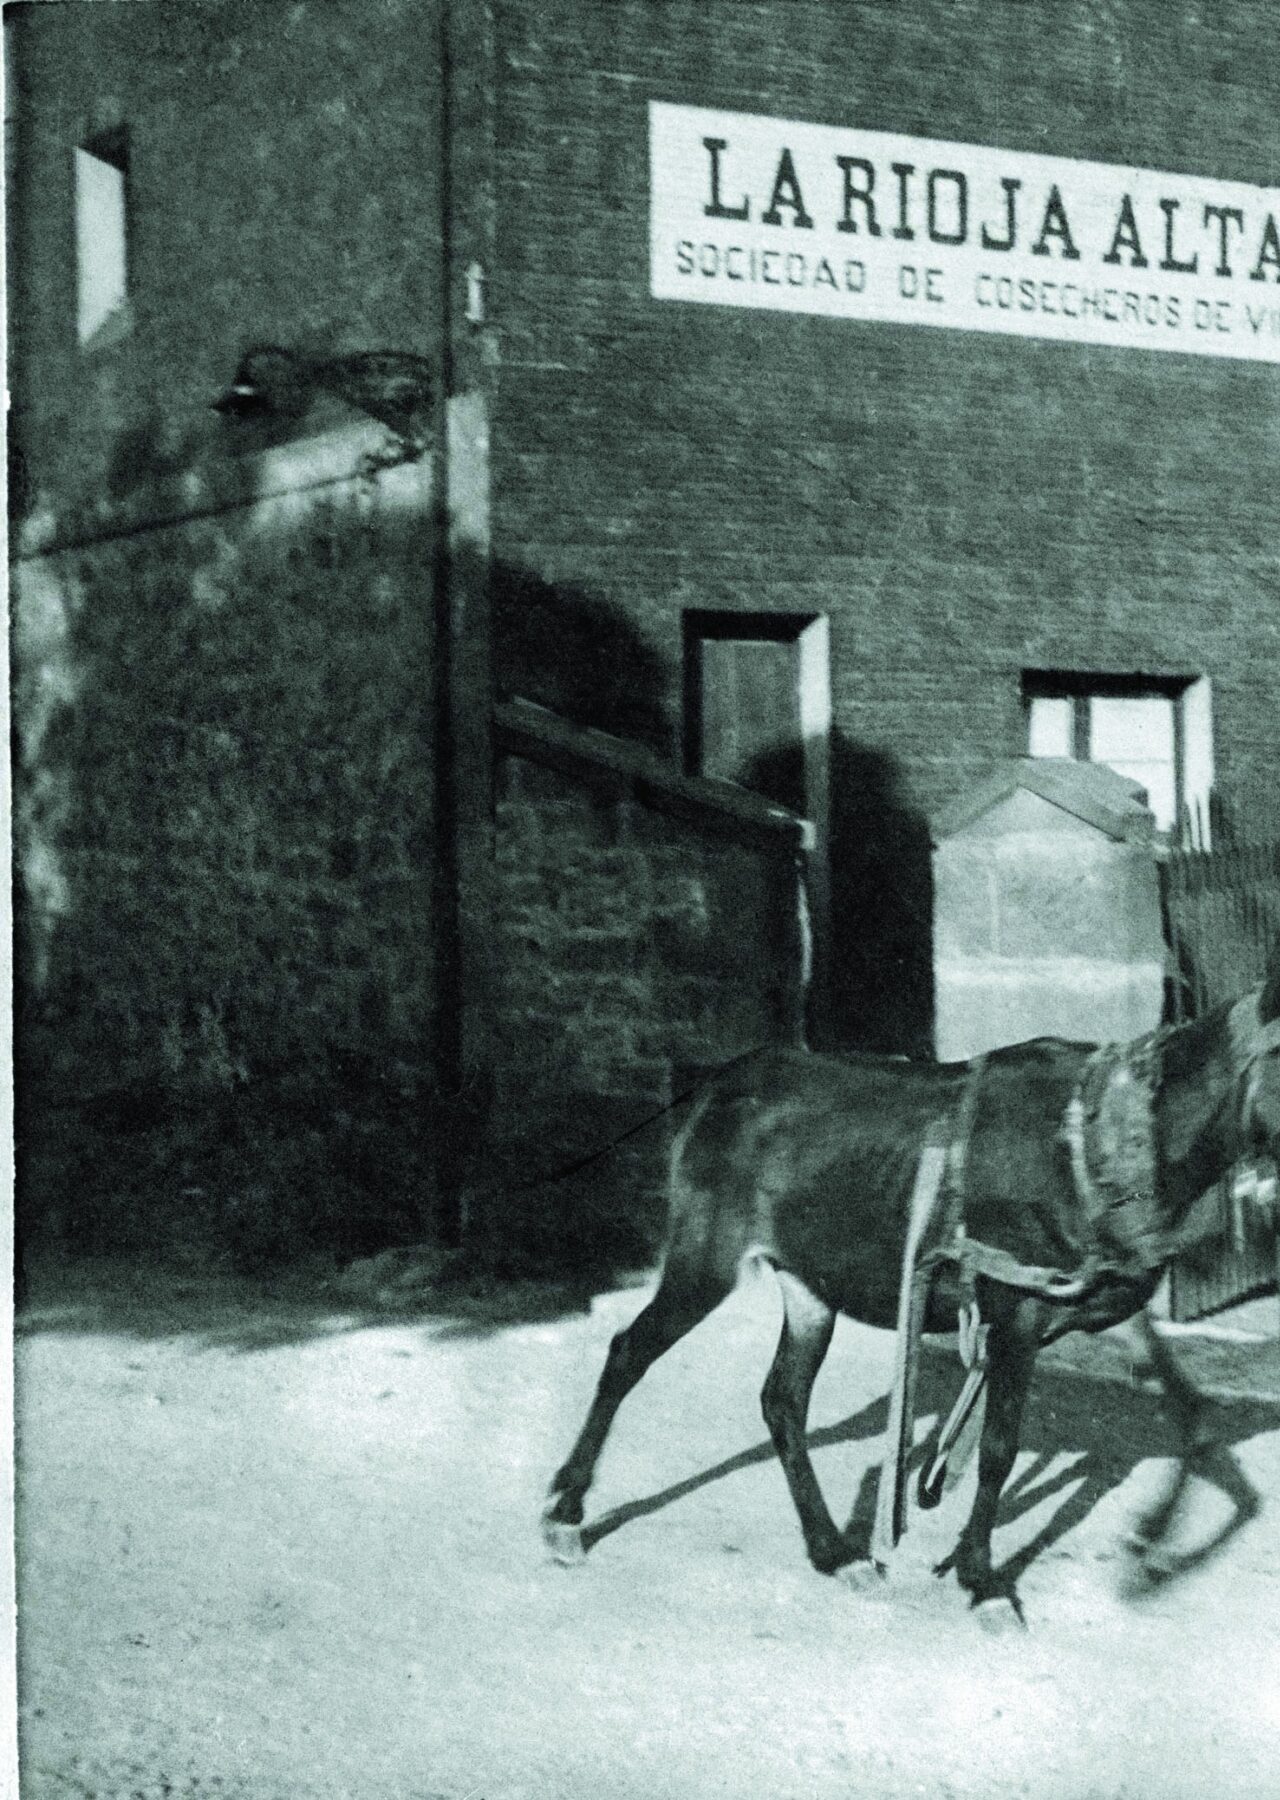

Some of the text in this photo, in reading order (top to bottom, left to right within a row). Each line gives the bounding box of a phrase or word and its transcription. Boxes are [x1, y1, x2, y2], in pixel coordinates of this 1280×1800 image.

[702, 137, 813, 229] LA
[836, 155, 1080, 260] RIOJA
[677, 240, 865, 293] SOCIEDAD
[899, 265, 944, 302] DE
[976, 273, 1180, 327] COSECHEROS
[1195, 299, 1231, 333] DE
